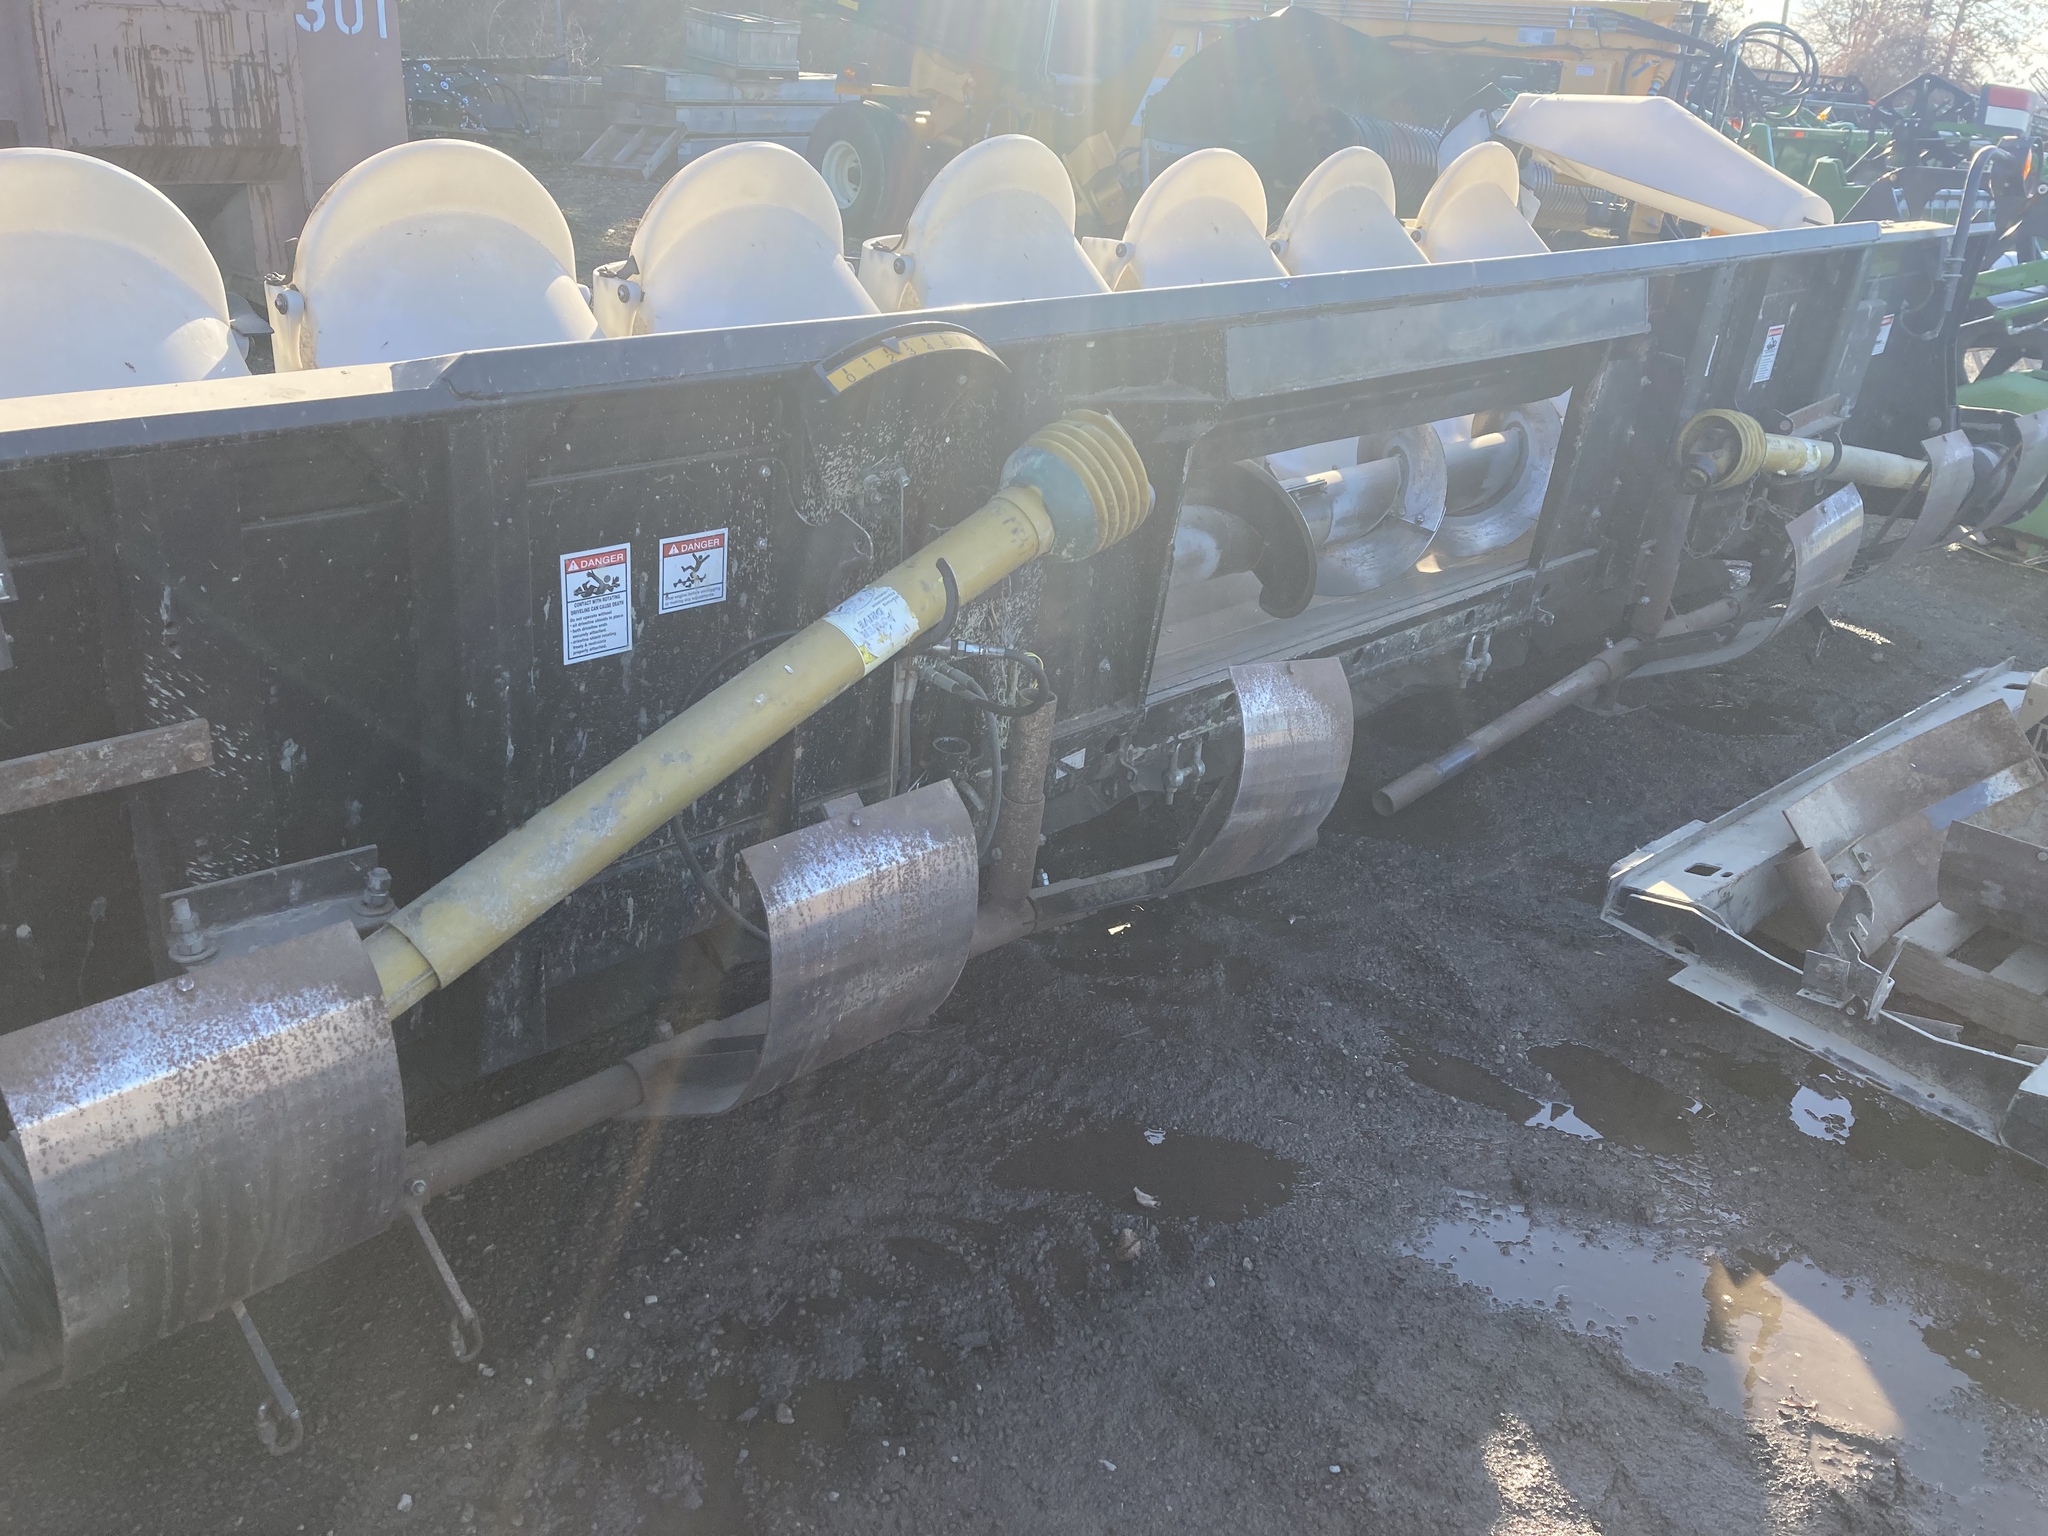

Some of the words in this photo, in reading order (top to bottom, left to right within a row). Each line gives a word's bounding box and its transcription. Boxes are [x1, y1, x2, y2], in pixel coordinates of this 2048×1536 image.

[846, 373, 857, 383] 0
[867, 362, 876, 372] 1
[886, 353, 896, 363] 2
[906, 347, 917, 356] 3
[927, 343, 935, 351] 4
[944, 340, 953, 348] 5
[681, 538, 720, 552] DANGER
[580, 553, 624, 568] DANGER
[571, 607, 590, 615] DRIVELINE
[857, 607, 885, 630] DRIVE
